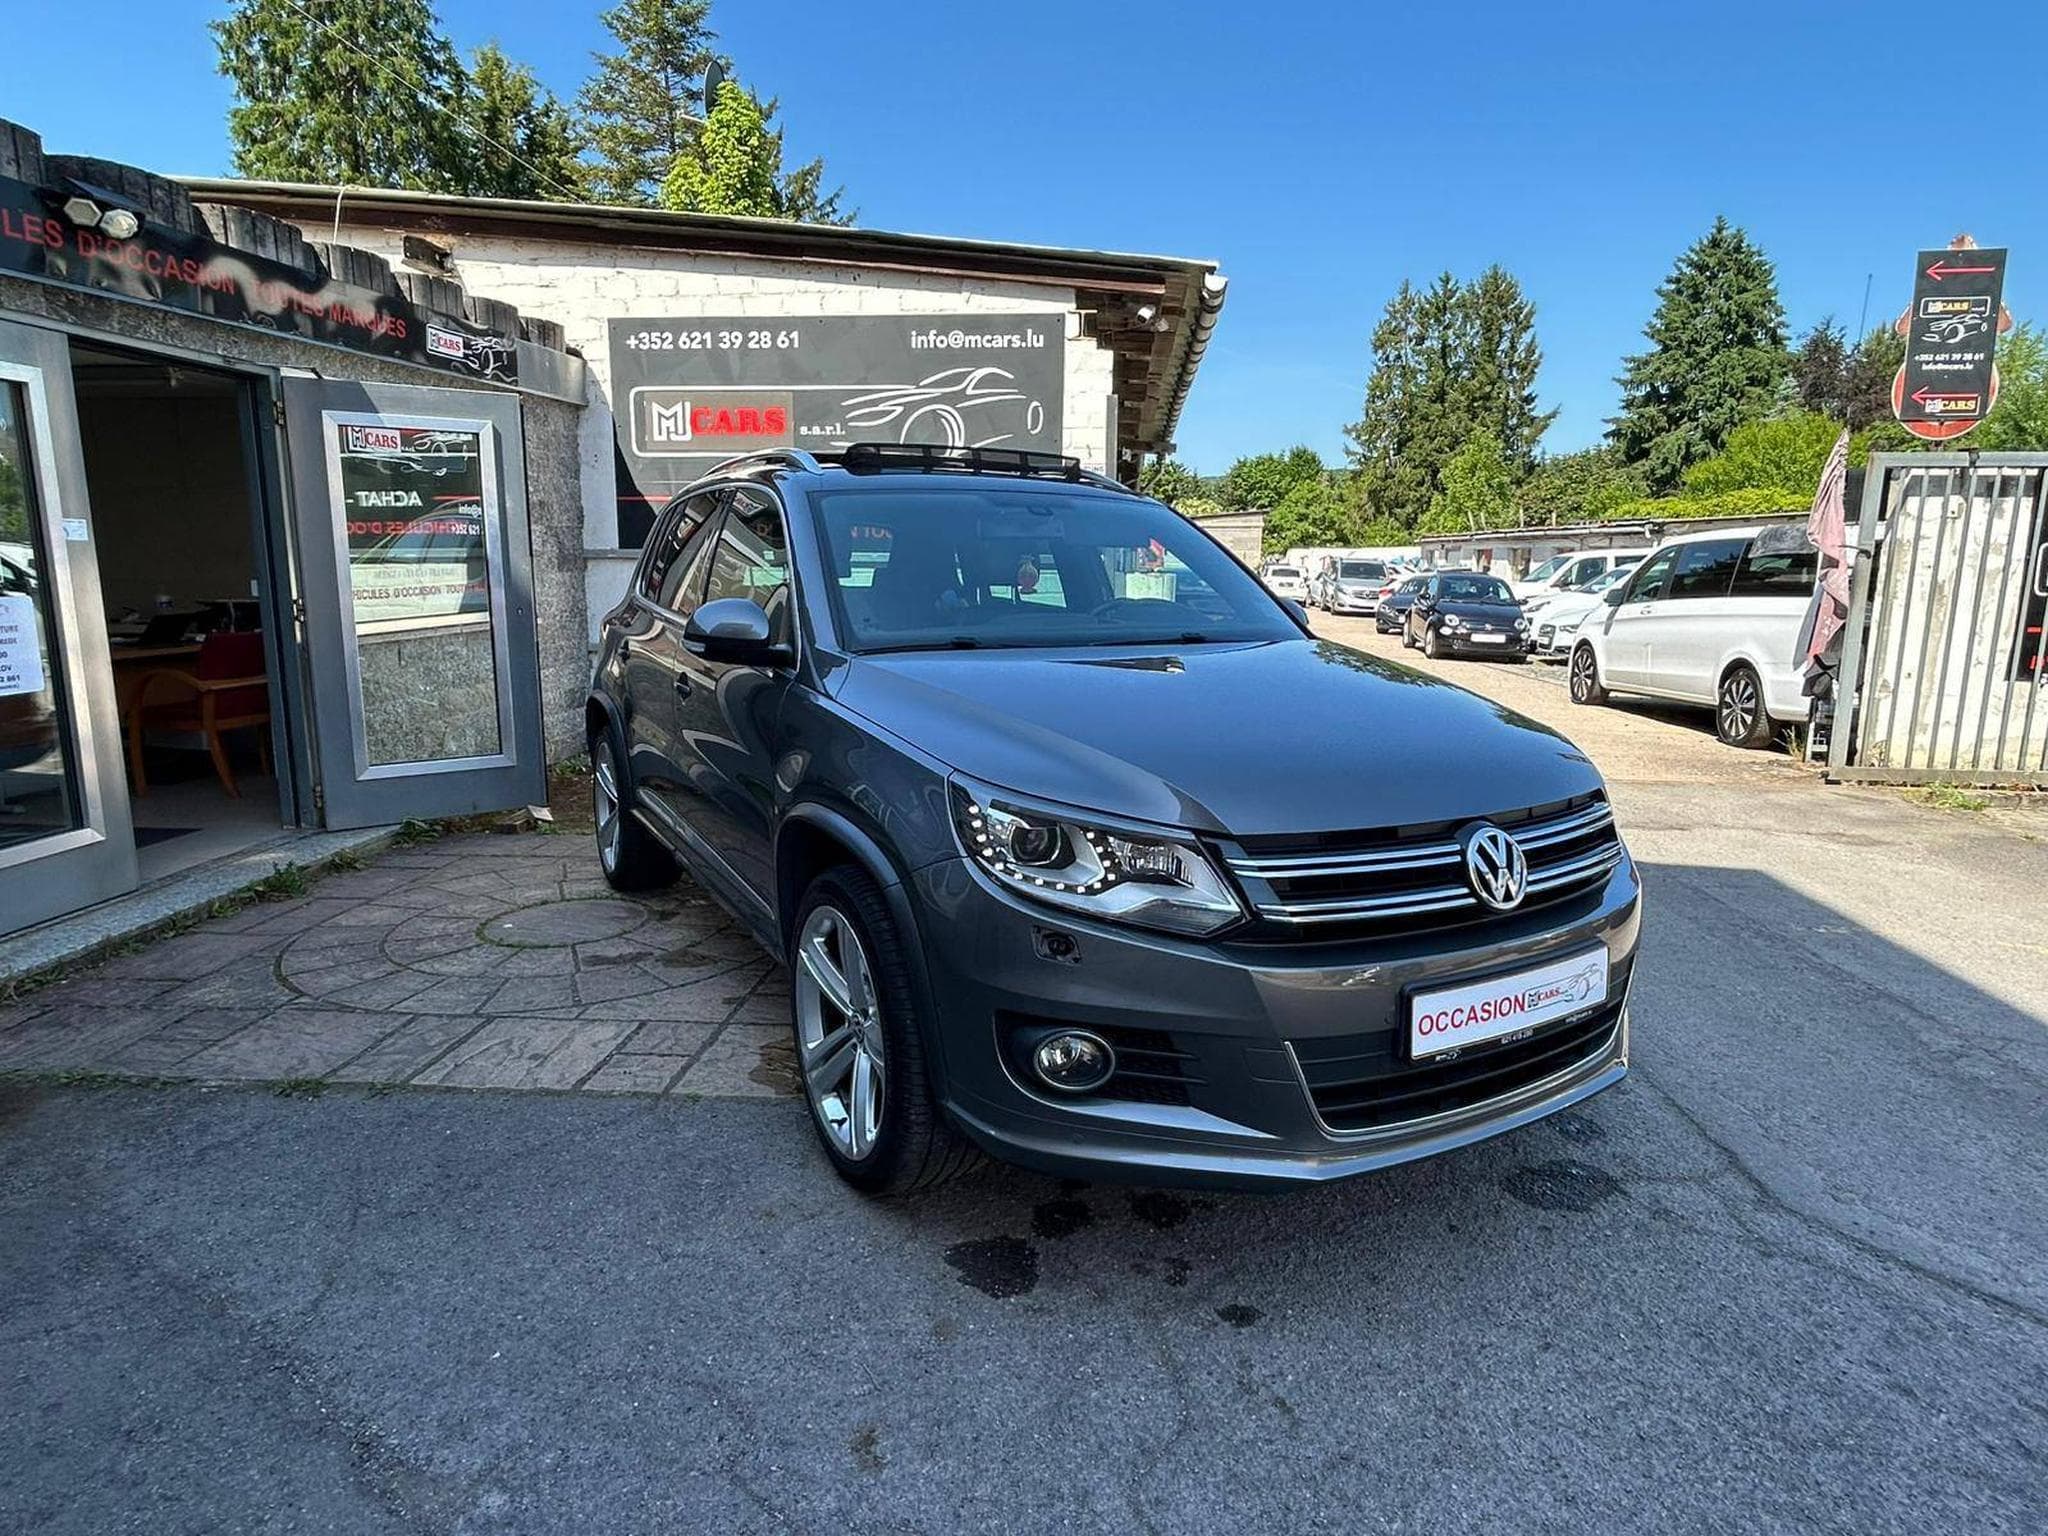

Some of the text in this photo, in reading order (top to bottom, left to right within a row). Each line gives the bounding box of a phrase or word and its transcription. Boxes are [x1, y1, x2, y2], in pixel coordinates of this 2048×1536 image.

[77, 231, 236, 295] D'OCCASION
[255, 281, 325, 317] TOUTES
[329, 302, 407, 339] MARQUES
[626, 330, 799, 350] +352 621 39 28 61
[911, 328, 1044, 349] info@mcars.lu
[1941, 399, 1977, 412] CARS
[691, 406, 787, 437] CARS
[365, 431, 399, 449] CARS
[1418, 992, 1527, 1037] OCCASION
